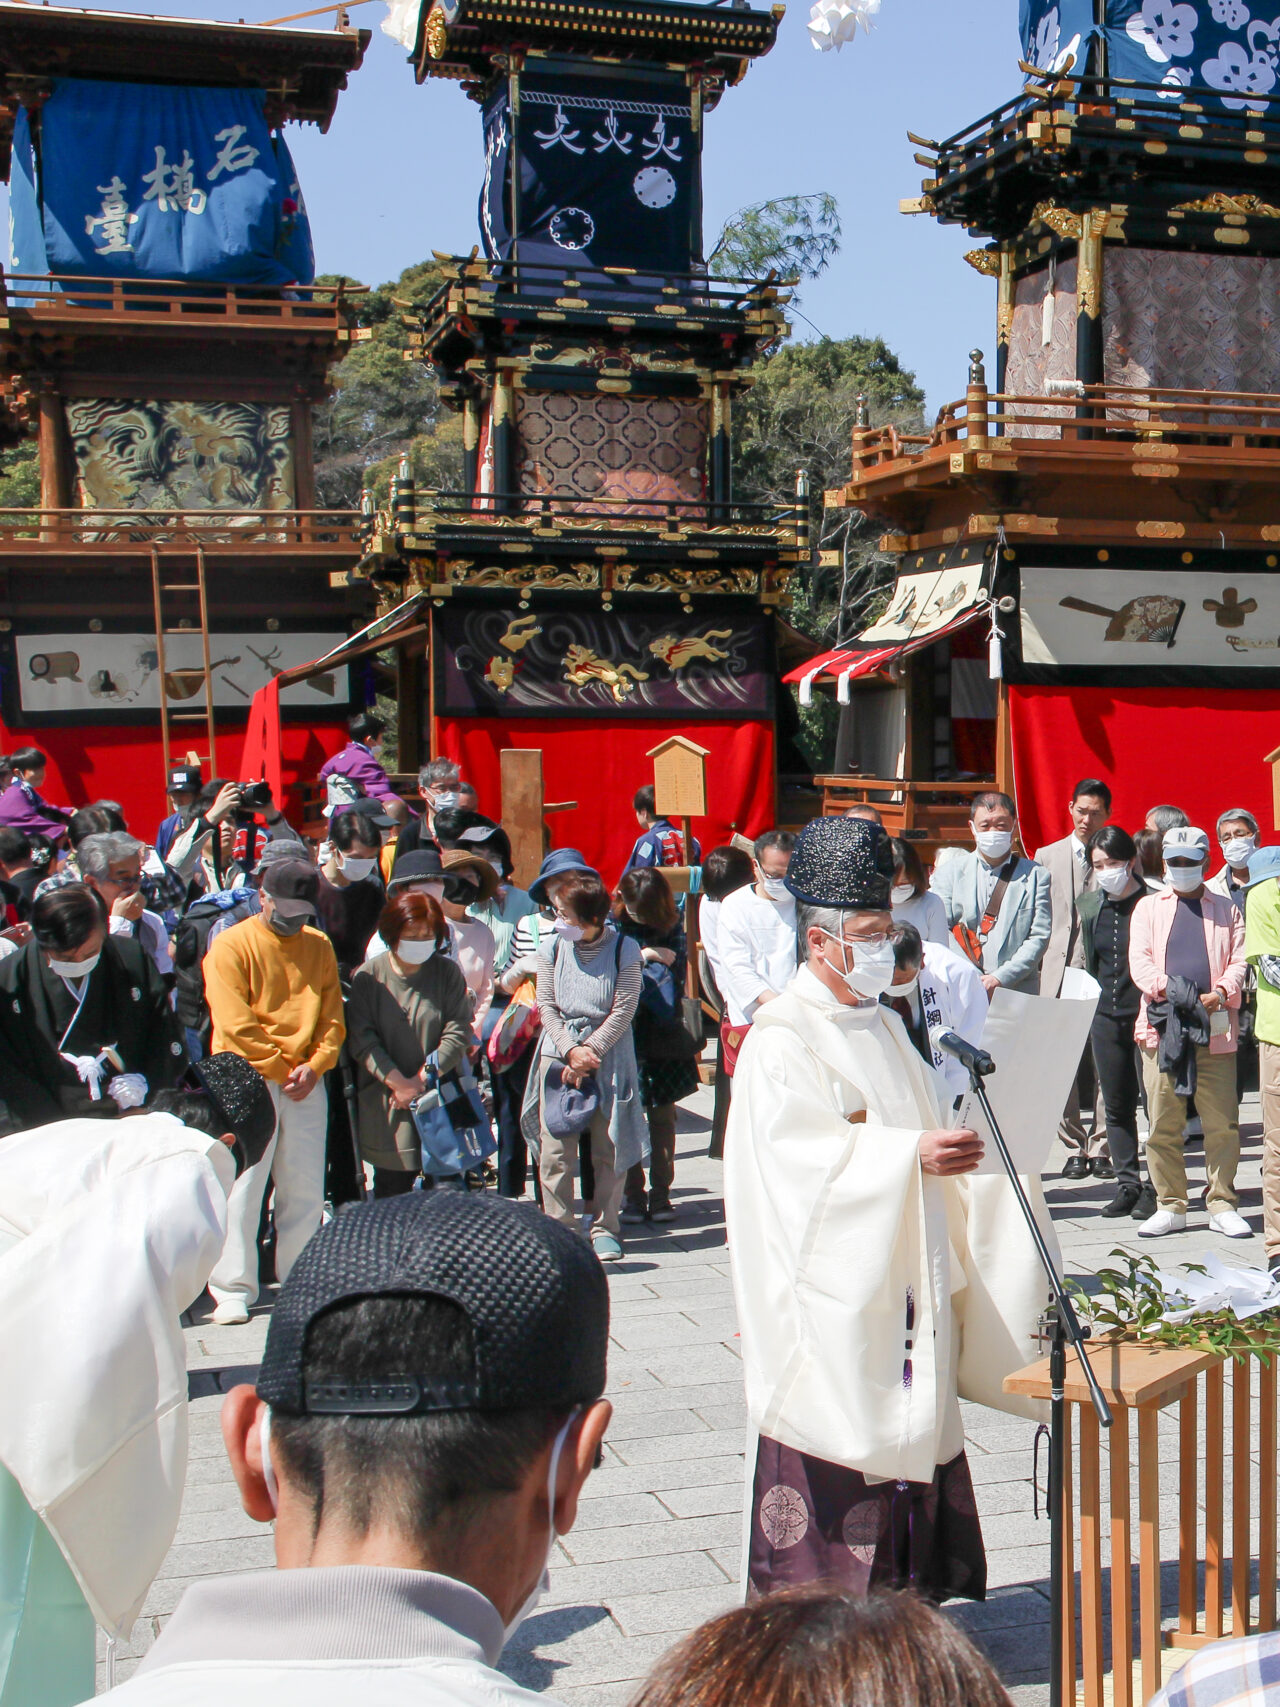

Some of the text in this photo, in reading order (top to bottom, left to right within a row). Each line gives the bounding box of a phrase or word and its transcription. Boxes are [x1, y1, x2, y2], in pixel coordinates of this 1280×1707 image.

[1177, 832, 1187, 842] N
[922, 987, 943, 1067] 針綱社
